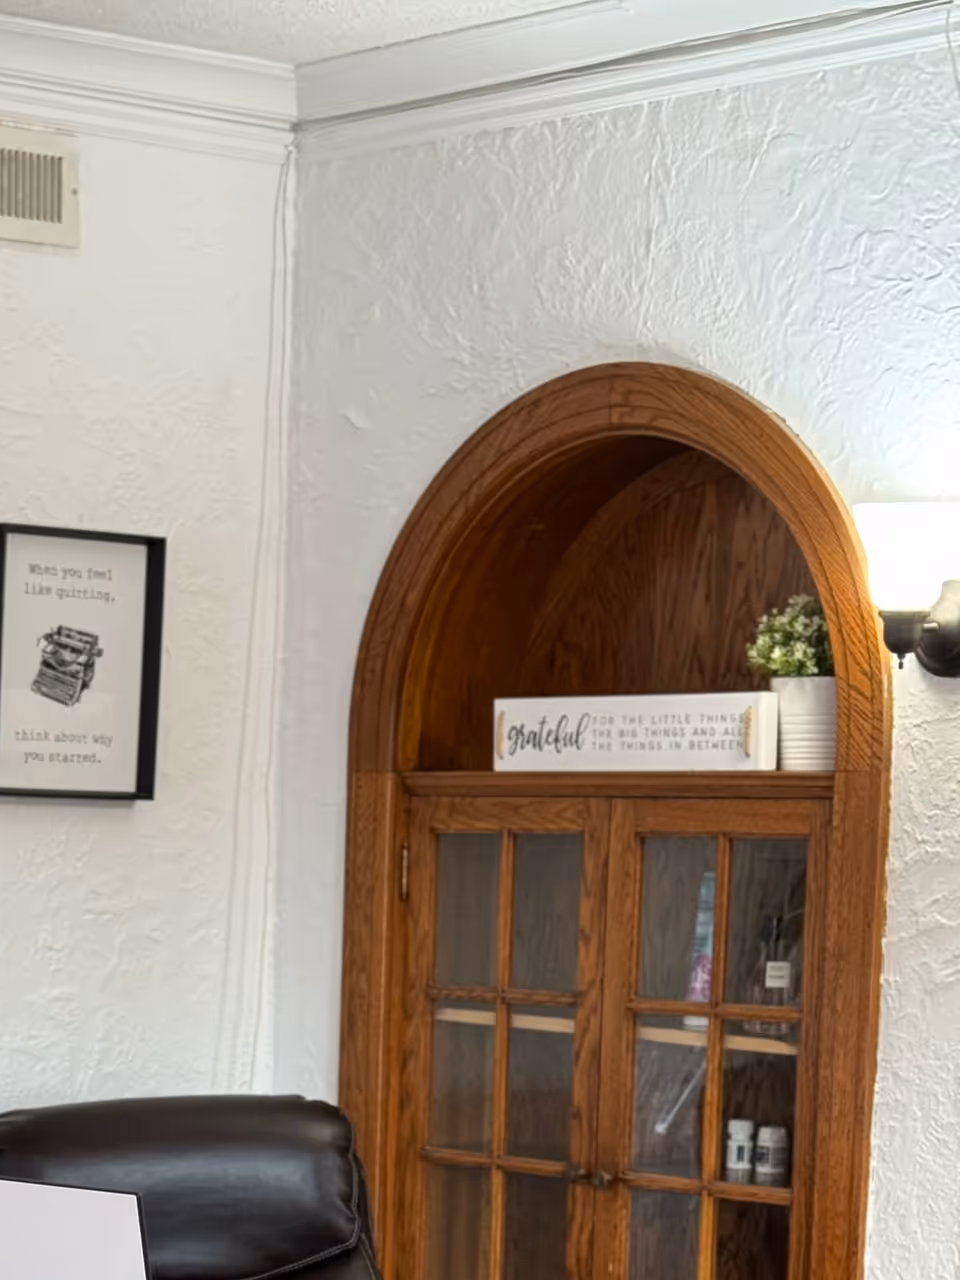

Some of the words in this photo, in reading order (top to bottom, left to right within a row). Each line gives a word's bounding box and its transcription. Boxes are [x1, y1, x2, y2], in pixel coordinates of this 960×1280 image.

[28, 563, 58, 577] When
[61, 567, 82, 581] you
[87, 567, 113, 581] feel
[24, 582, 52, 596] like
[56, 586, 115, 606] quitting,
[592, 715, 615, 726] FOR
[622, 714, 643, 726] THE
[651, 713, 691, 725] LITTLE
[15, 729, 50, 741] think
[53, 732, 88, 745] about
[91, 735, 113, 748] why
[592, 728, 612, 739] THE
[618, 728, 638, 739] BIG
[644, 727, 686, 738] THINGS
[692, 727, 717, 737] AND
[722, 725, 744, 737] ALL
[592, 741, 613, 752] THE
[620, 741, 663, 752] THINGS
[669, 740, 683, 751] IN
[689, 739, 744, 751] BETWEEN
[23, 752, 45, 765] you
[48, 752, 102, 764] started.
